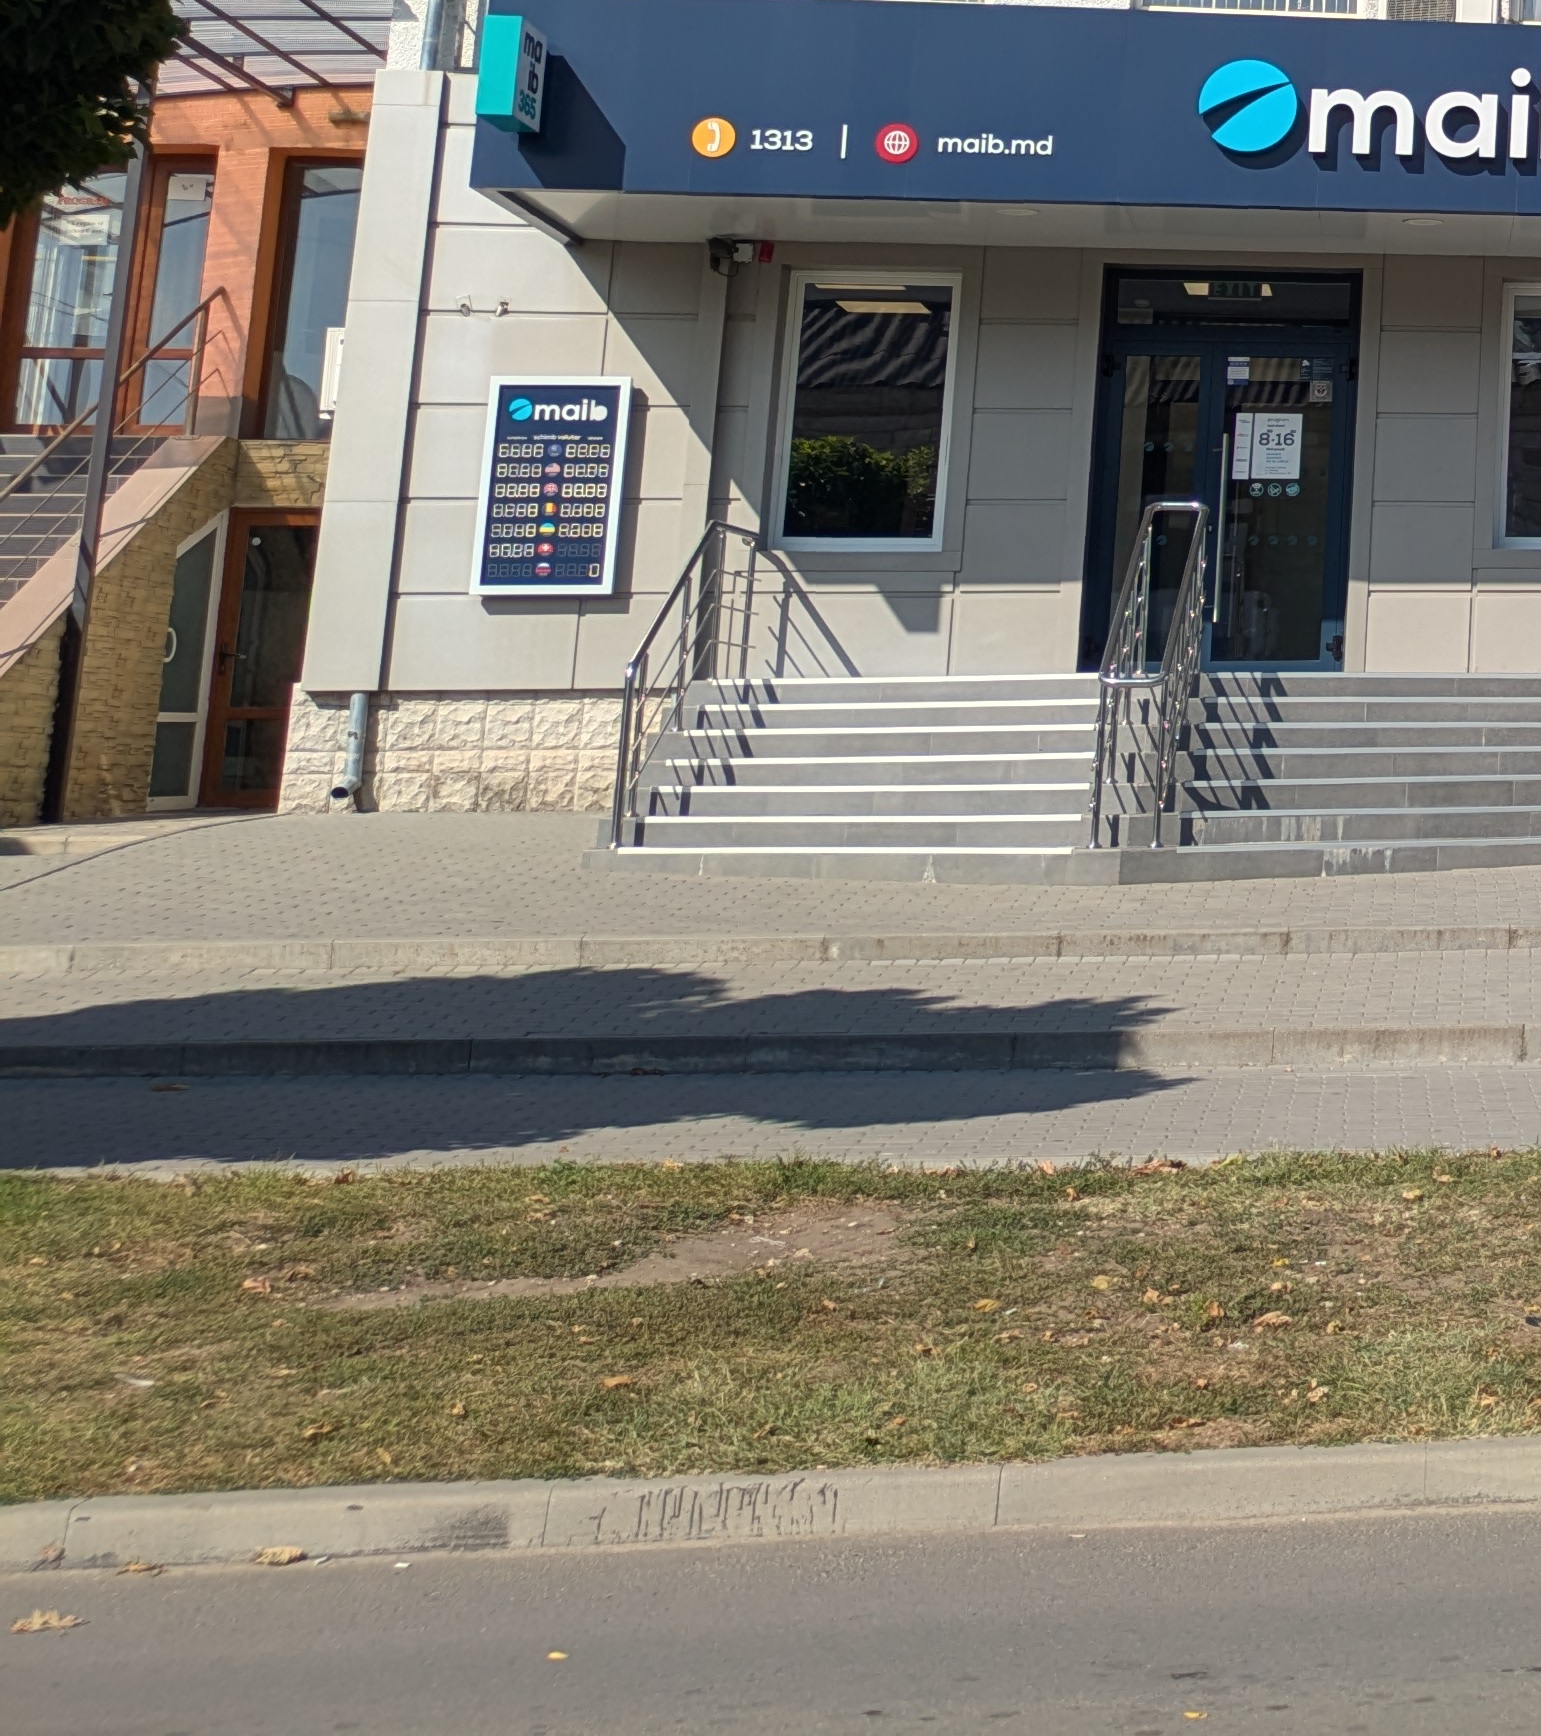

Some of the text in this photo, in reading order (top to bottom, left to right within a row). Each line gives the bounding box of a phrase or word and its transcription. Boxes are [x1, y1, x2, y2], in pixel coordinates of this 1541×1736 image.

[518, 88, 537, 120] 365
[750, 128, 1053, 157] 1313 maib.md
[1213, 282, 1256, 297] EXIT
[533, 398, 608, 422] maib
